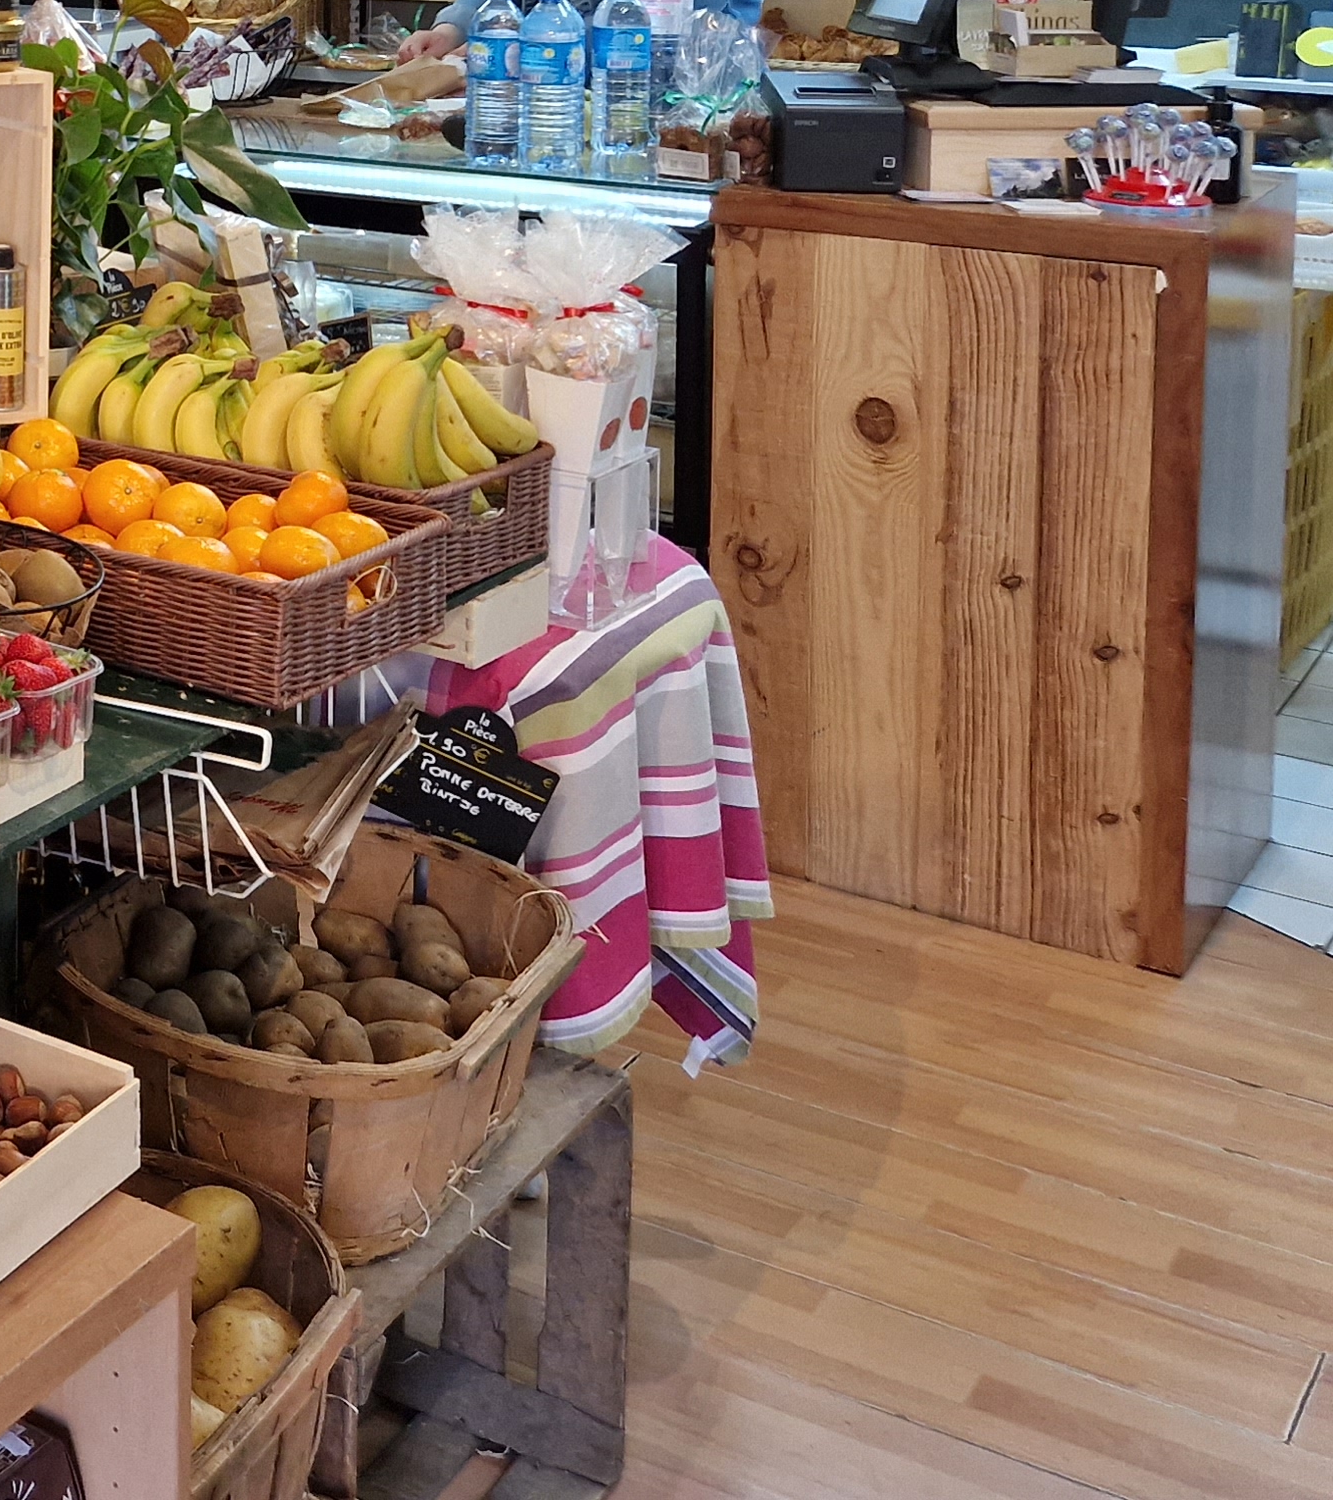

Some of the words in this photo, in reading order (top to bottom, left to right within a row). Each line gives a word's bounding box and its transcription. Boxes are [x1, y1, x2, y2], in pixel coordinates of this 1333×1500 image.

[479, 712, 491, 727] la
[464, 720, 499, 743] Pièce
[419, 752, 473, 791] POMME
